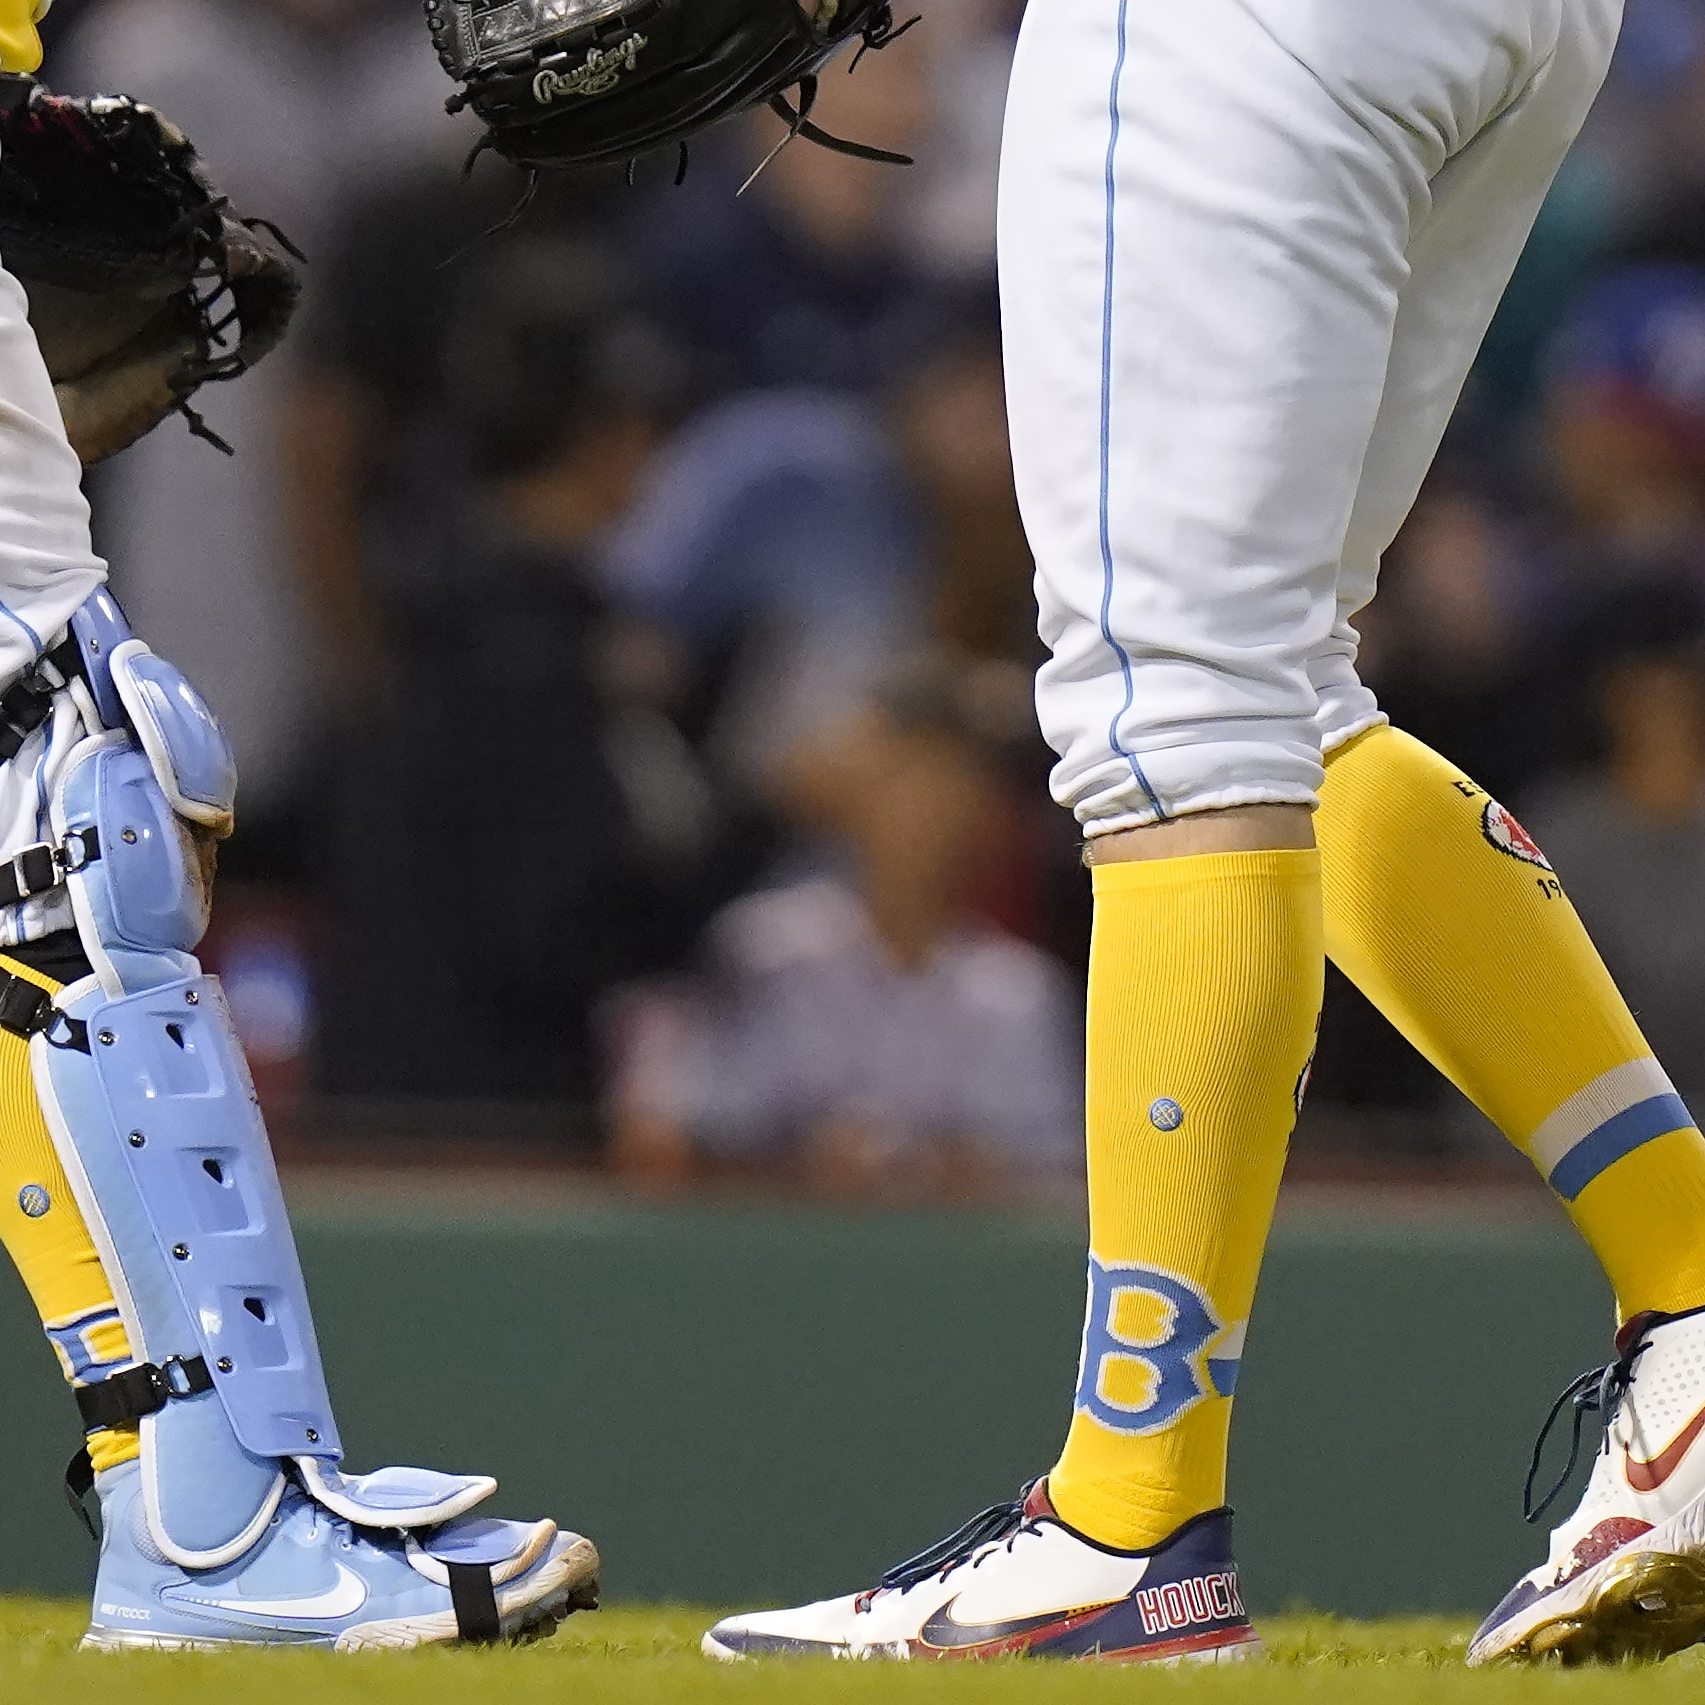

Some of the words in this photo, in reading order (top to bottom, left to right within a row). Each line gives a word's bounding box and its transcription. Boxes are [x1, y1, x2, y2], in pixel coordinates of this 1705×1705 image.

[532, 32, 649, 105] Rawlings
[1076, 1248, 1222, 1437] B
[1136, 1571, 1246, 1636] HOUCK
